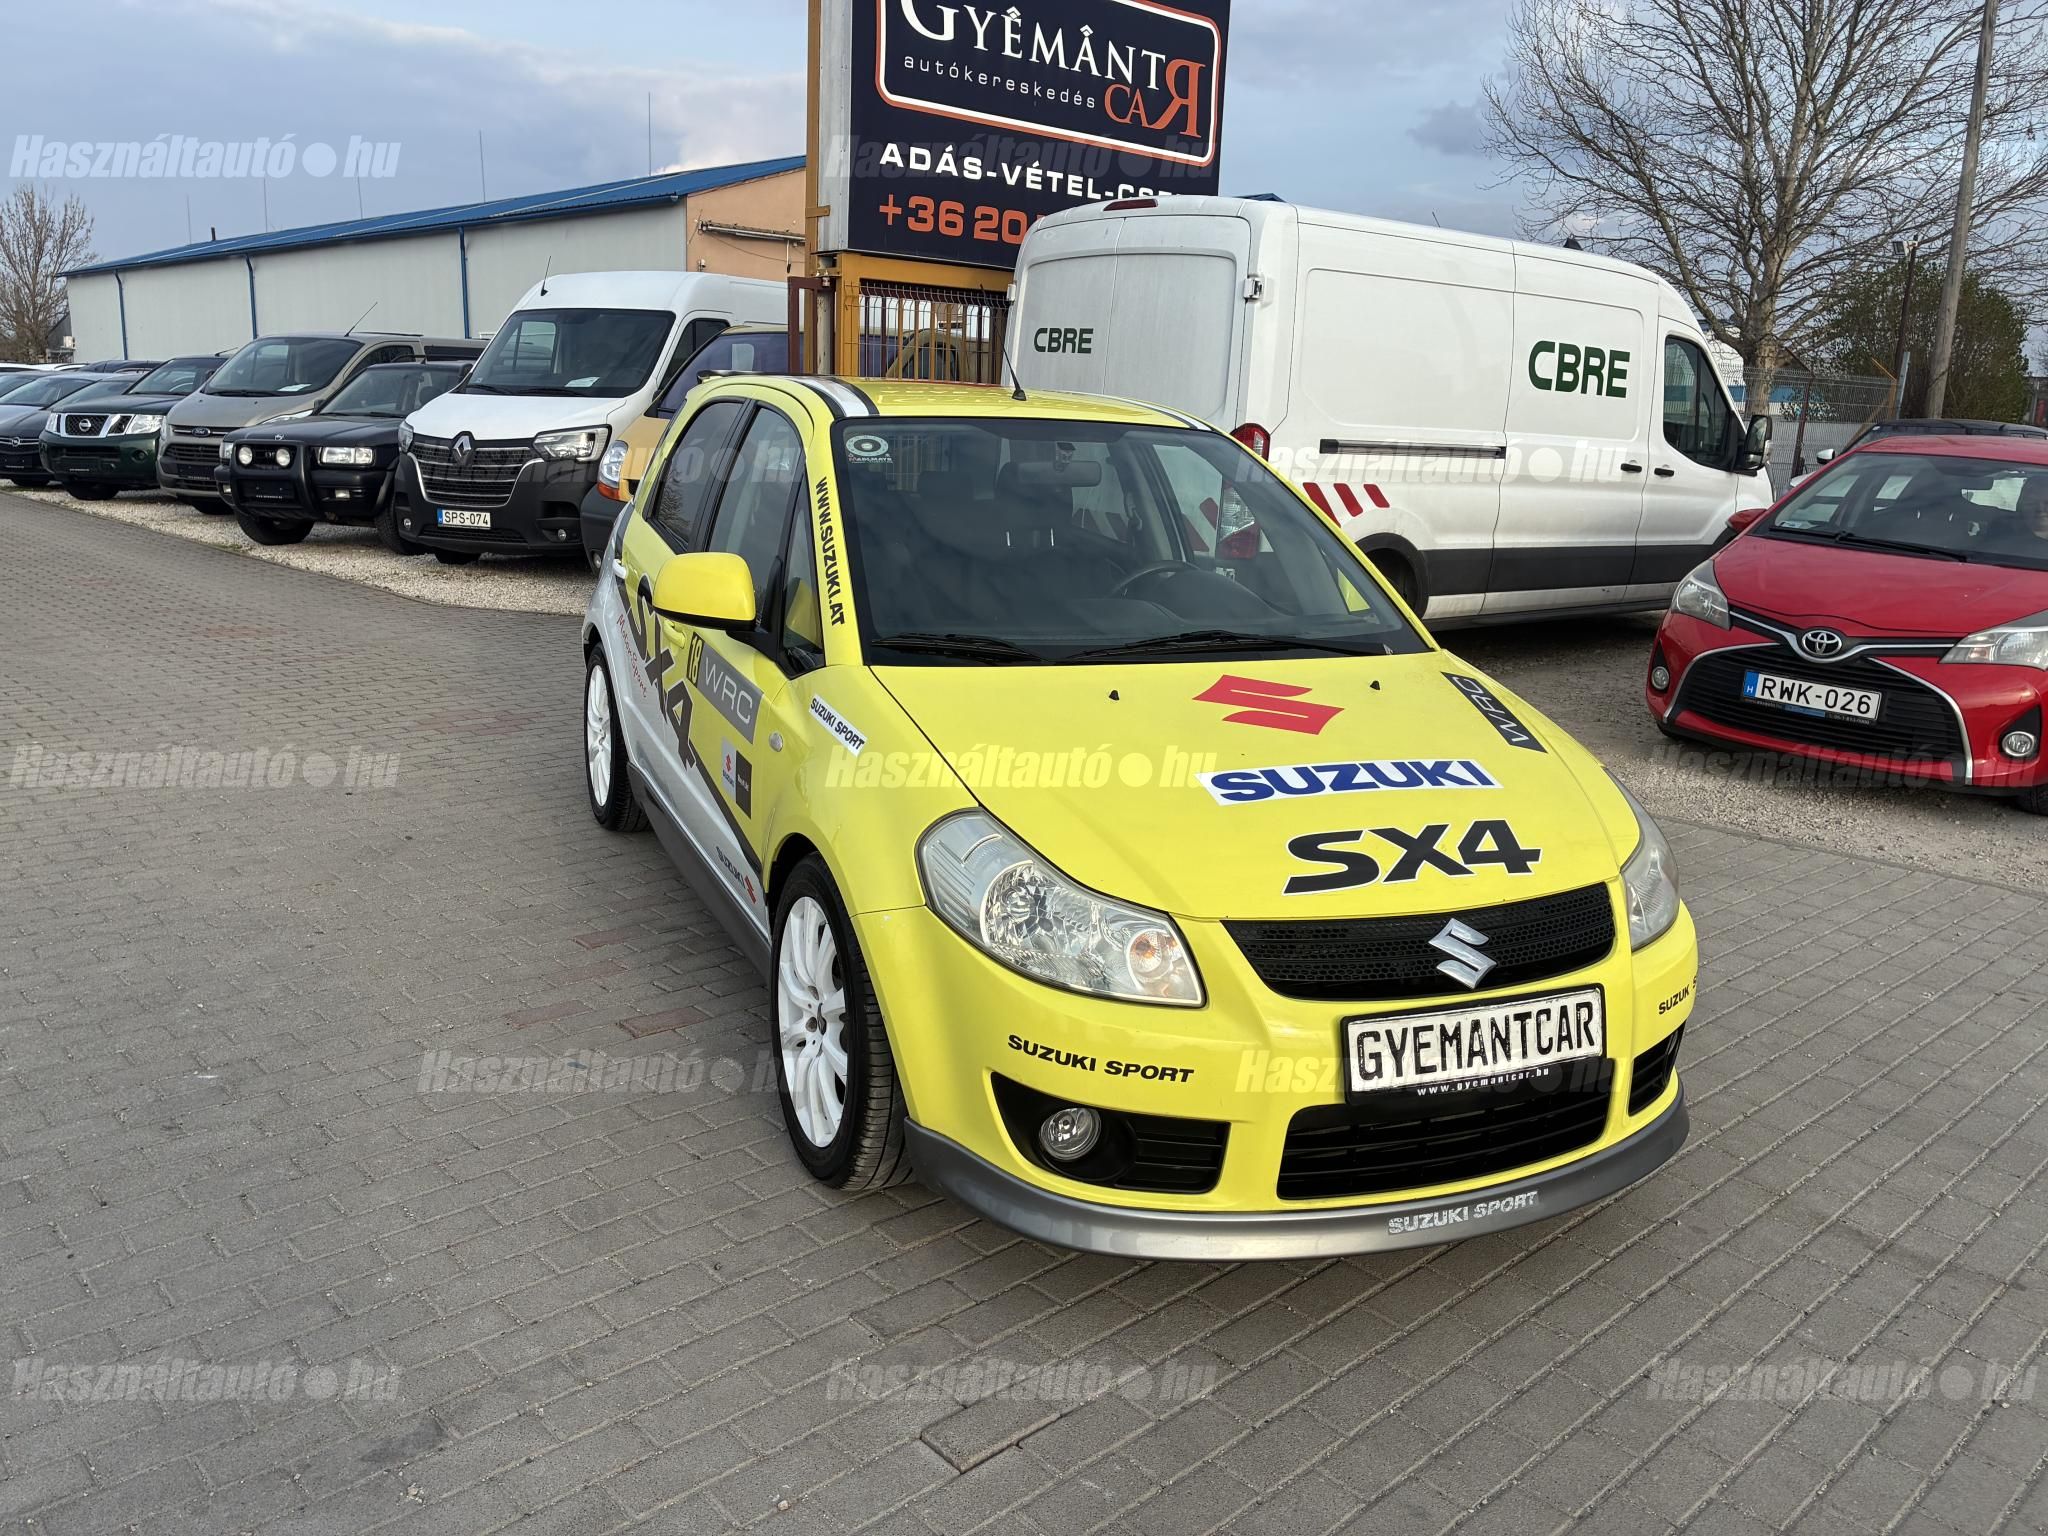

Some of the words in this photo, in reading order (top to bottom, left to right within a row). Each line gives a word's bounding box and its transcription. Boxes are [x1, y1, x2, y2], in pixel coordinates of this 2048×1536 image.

[904, 55, 1096, 109] autókereskedés
[1033, 327, 1094, 354] CBRE
[1528, 340, 1631, 399] CBRE
[444, 511, 489, 525] SPS-074
[816, 476, 845, 626] WWW.SUZUKI.AT
[705, 657, 753, 725] WRC
[1760, 677, 1872, 715] RWK-026
[810, 698, 837, 727] SUZUKI
[835, 721, 865, 750] SPORT
[1210, 760, 1496, 802] SUZUKI
[1282, 818, 1542, 896] SX4
[1008, 1034, 1097, 1072] SUZUKI
[1104, 1060, 1195, 1083] SPORT
[1356, 1001, 1596, 1081] GYEMANTCAR
[1417, 1067, 1550, 1096] www.gyemantcar.hu
[1388, 1206, 1469, 1234] SUZUKI
[1473, 1191, 1538, 1218] SPORT
